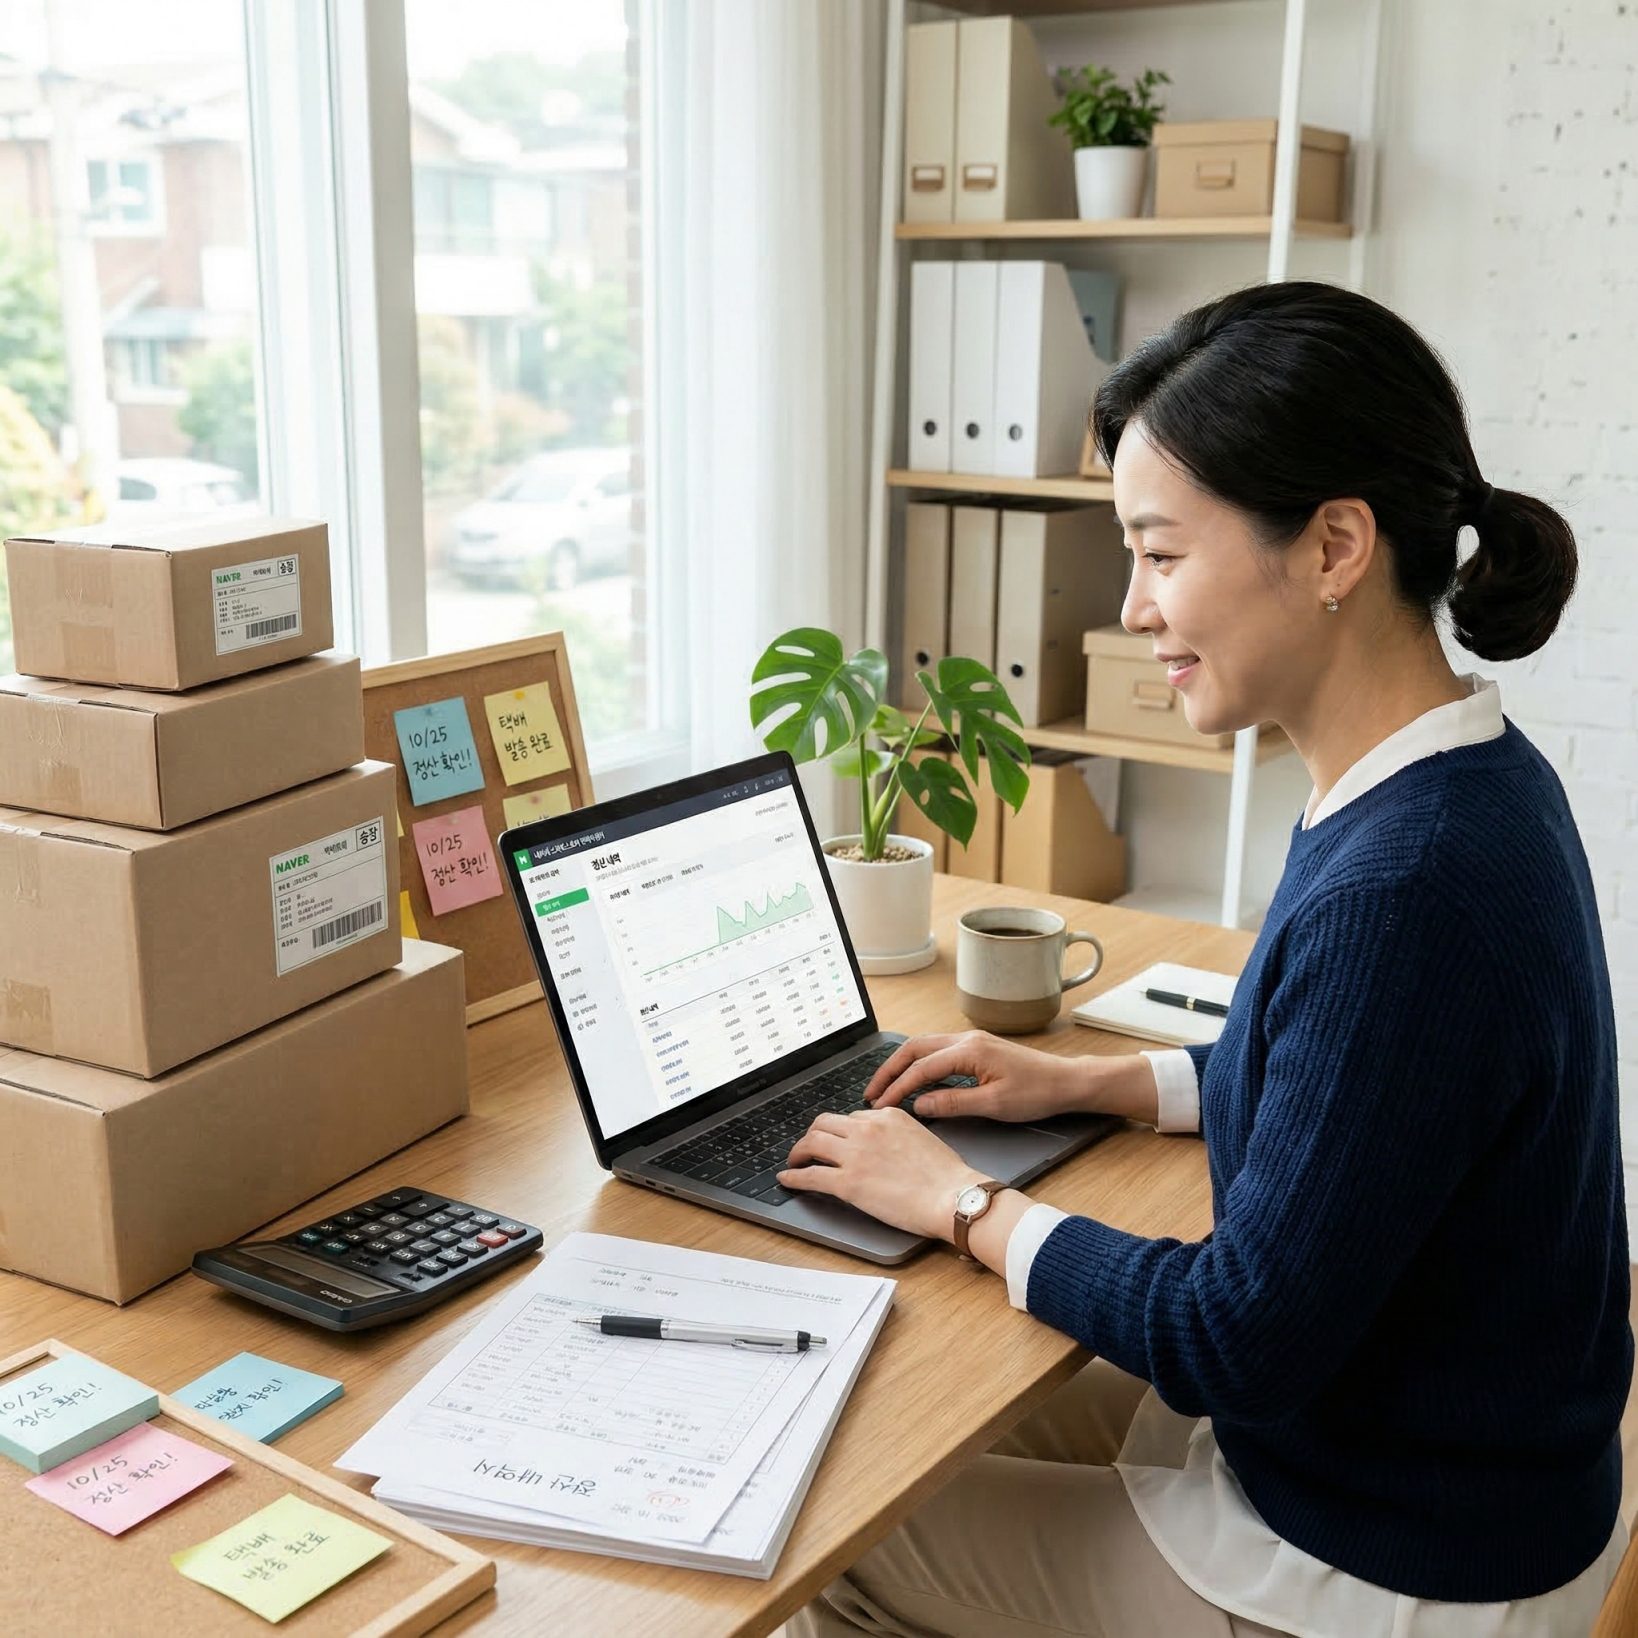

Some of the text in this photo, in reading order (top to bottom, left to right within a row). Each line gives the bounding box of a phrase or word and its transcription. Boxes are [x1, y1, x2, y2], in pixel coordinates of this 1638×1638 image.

[498, 711, 528, 733] 택배
[409, 725, 447, 748] 10/25
[530, 732, 553, 754] 완료
[412, 748, 472, 780] 정산 확인!
[426, 834, 462, 857] 10/25
[275, 854, 310, 875] NAVER
[431, 852, 489, 886] 정산 확인!
[0, 1383, 53, 1415] 10/25
[13, 1407, 56, 1427] 정산
[67, 1454, 128, 1490] 10/25
[223, 1533, 277, 1560] 택배
